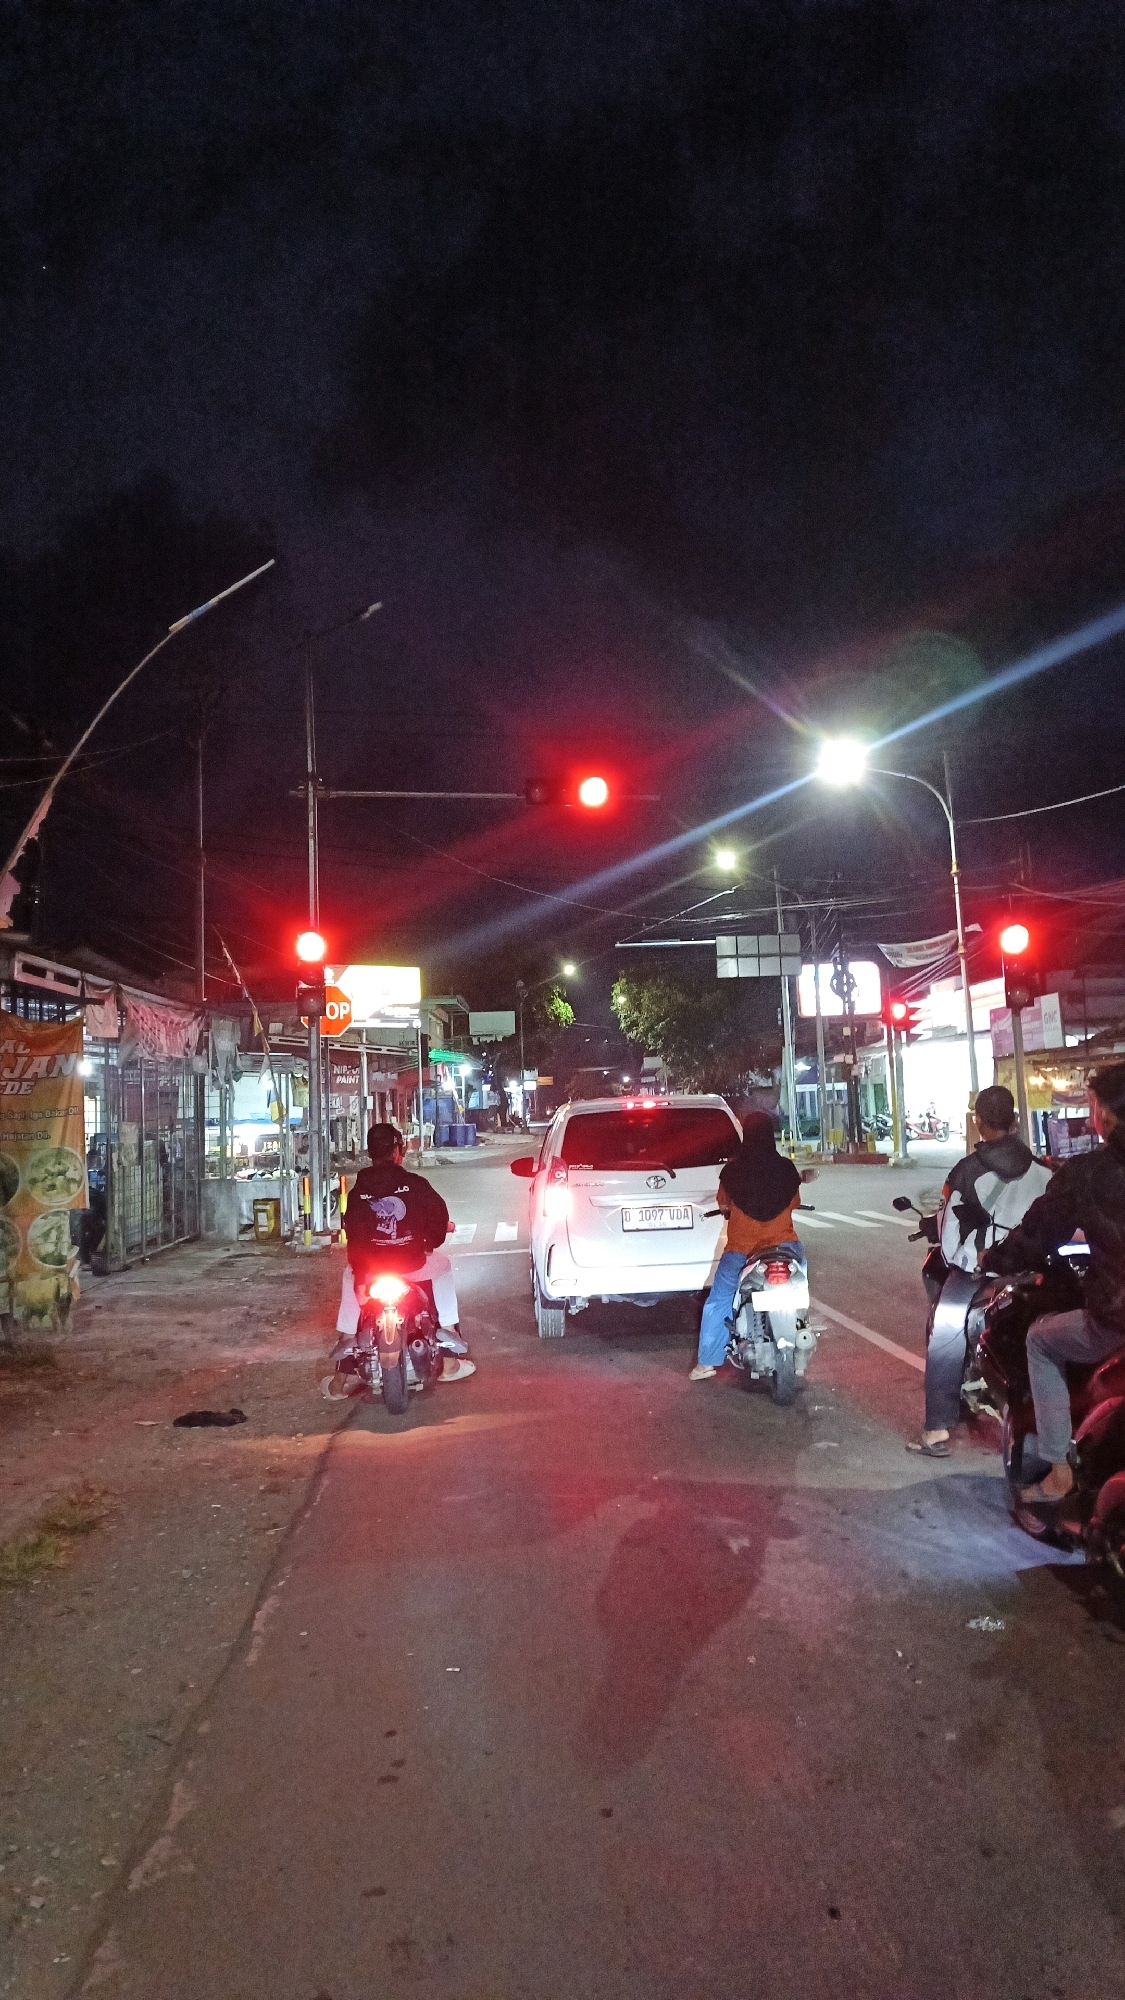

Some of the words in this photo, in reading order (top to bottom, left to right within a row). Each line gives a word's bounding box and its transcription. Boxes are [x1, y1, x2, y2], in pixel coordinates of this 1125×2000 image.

[326, 1001, 350, 1020] OP
[336, 1075, 360, 1084] PAINT
[638, 1209, 664, 1221] 1097
[669, 1208, 689, 1220] VDA
